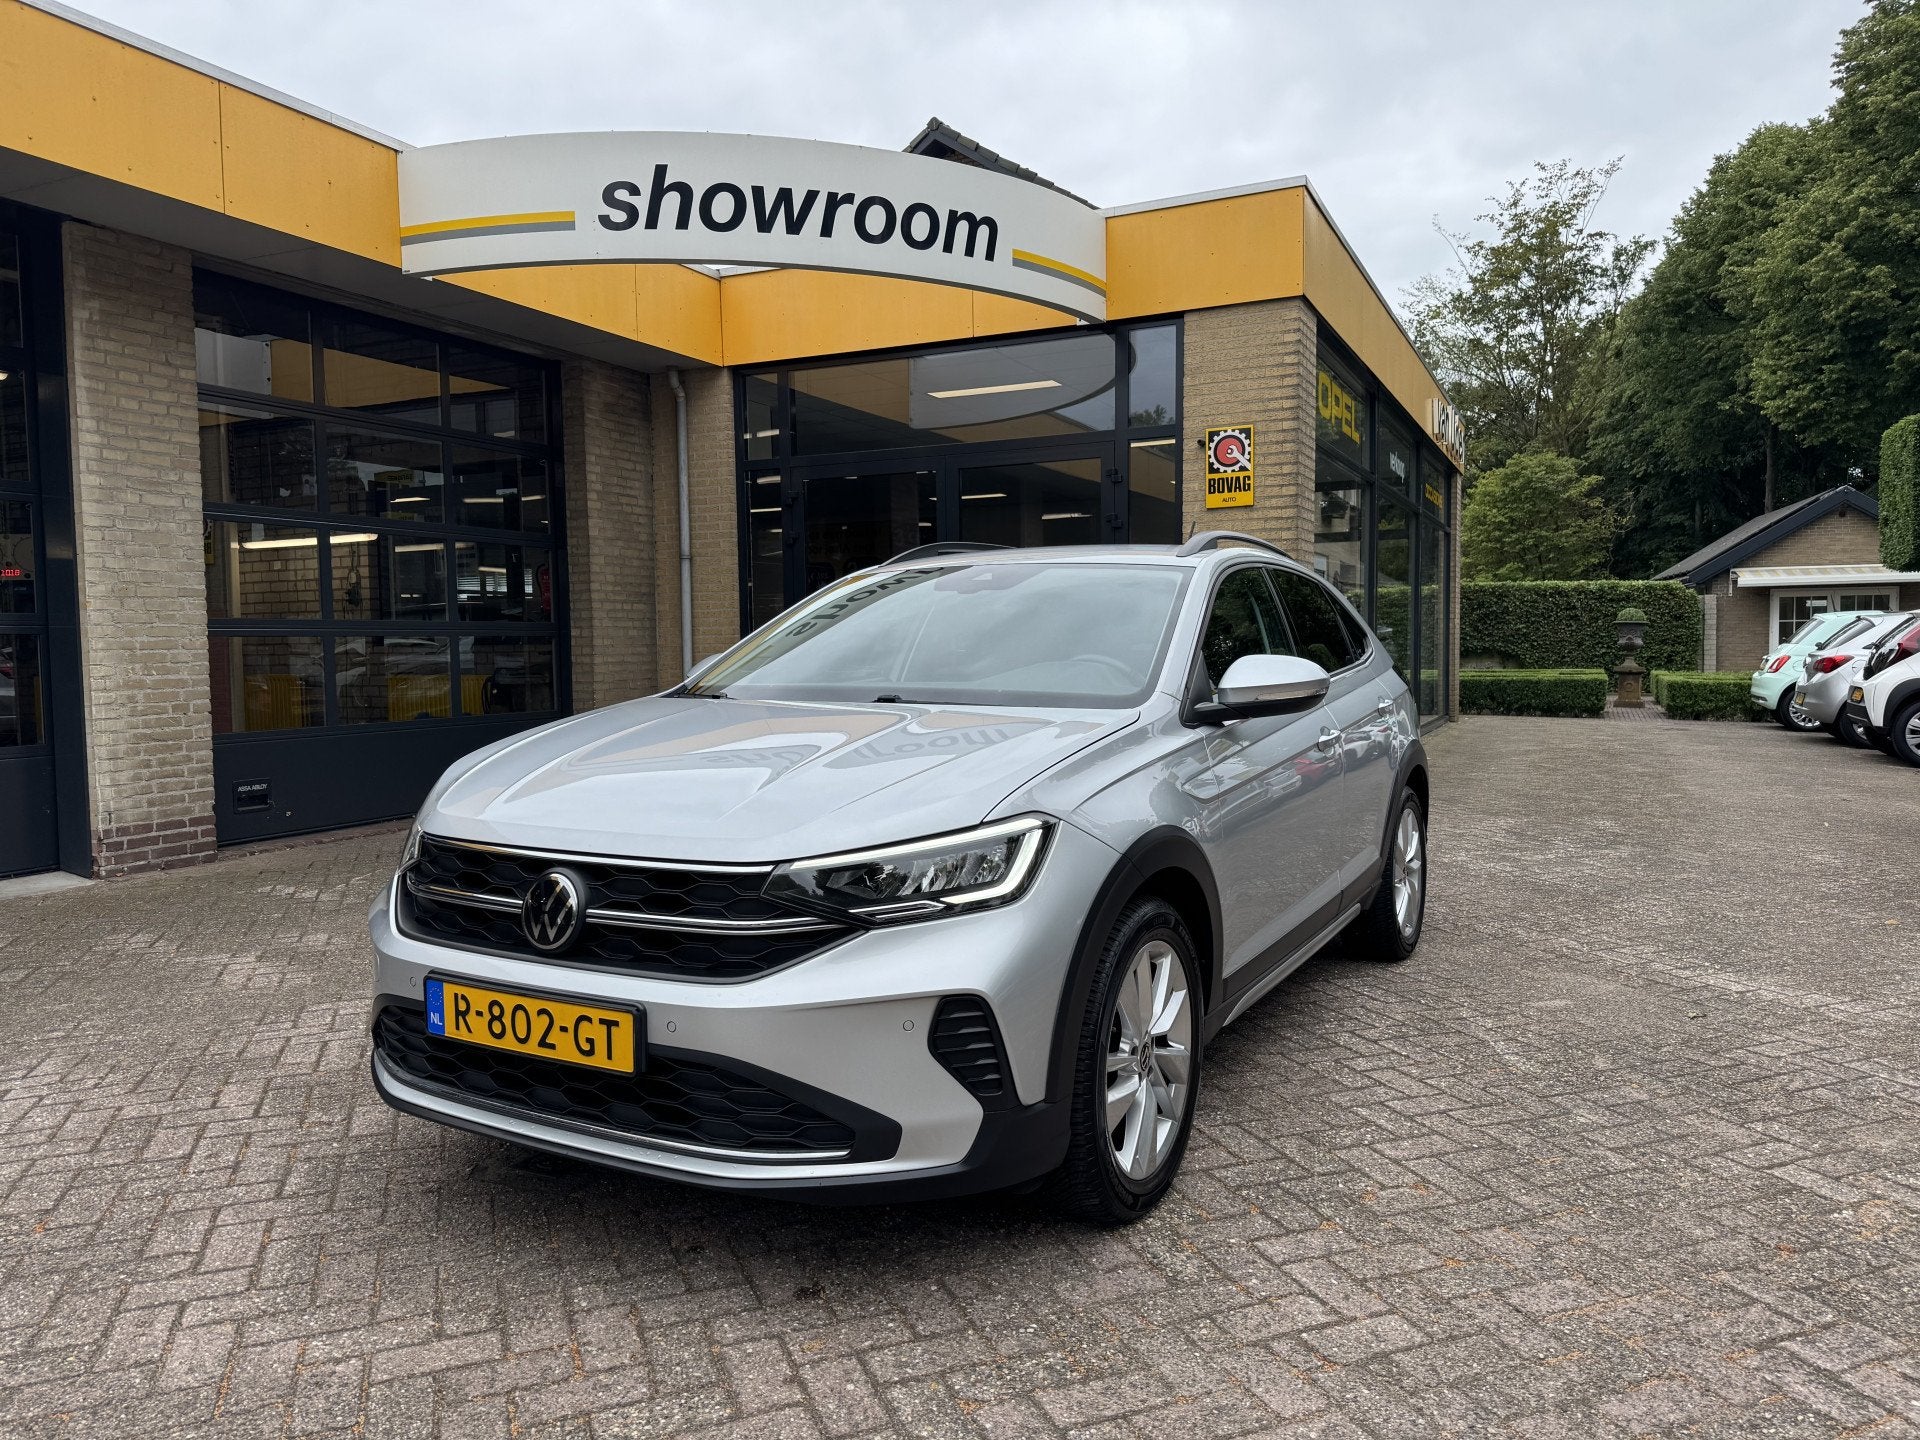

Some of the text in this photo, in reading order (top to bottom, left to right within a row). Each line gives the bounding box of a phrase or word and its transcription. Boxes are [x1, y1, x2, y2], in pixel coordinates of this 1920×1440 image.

[597, 163, 999, 262] showroom
[1318, 370, 1361, 445] OPEL
[1208, 475, 1251, 495] BOVAG
[430, 1012, 443, 1026] NL
[453, 992, 620, 1061] R-802-GT
